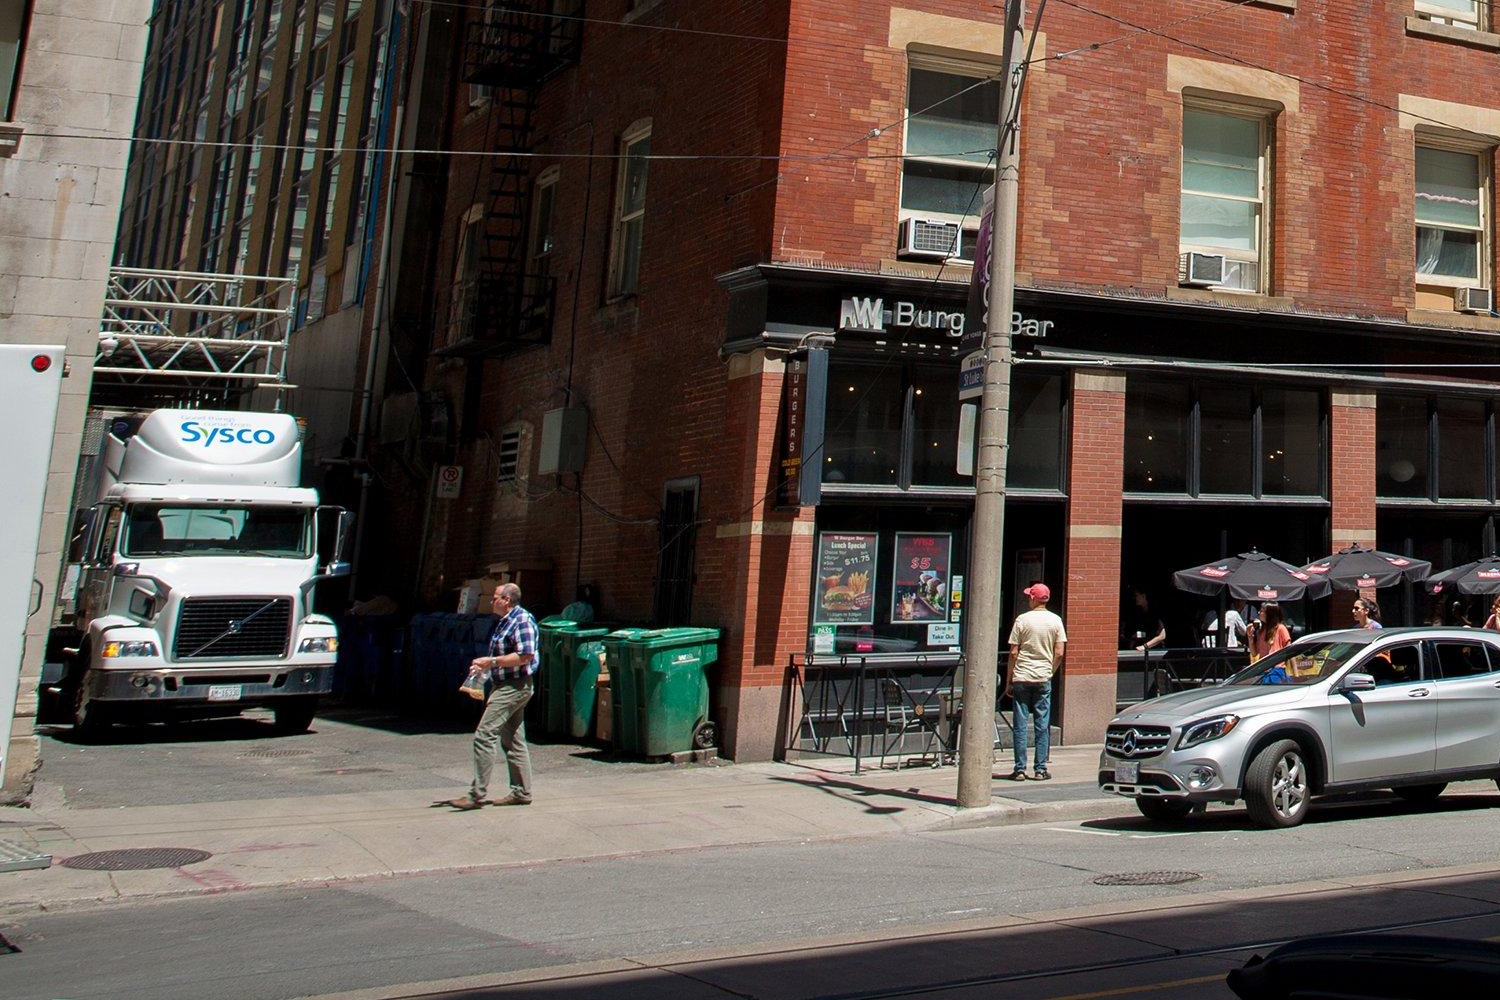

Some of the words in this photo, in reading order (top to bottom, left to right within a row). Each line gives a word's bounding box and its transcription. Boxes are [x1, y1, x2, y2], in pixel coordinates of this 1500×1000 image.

[896, 301, 965, 337] Burg
[1010, 312, 1055, 337] Bar
[789, 360, 800, 452] BURGERS
[181, 421, 275, 447] Sysco
[847, 541, 866, 550] Special
[844, 555, 870, 566] $11.75
[910, 557, 931, 570] $5
